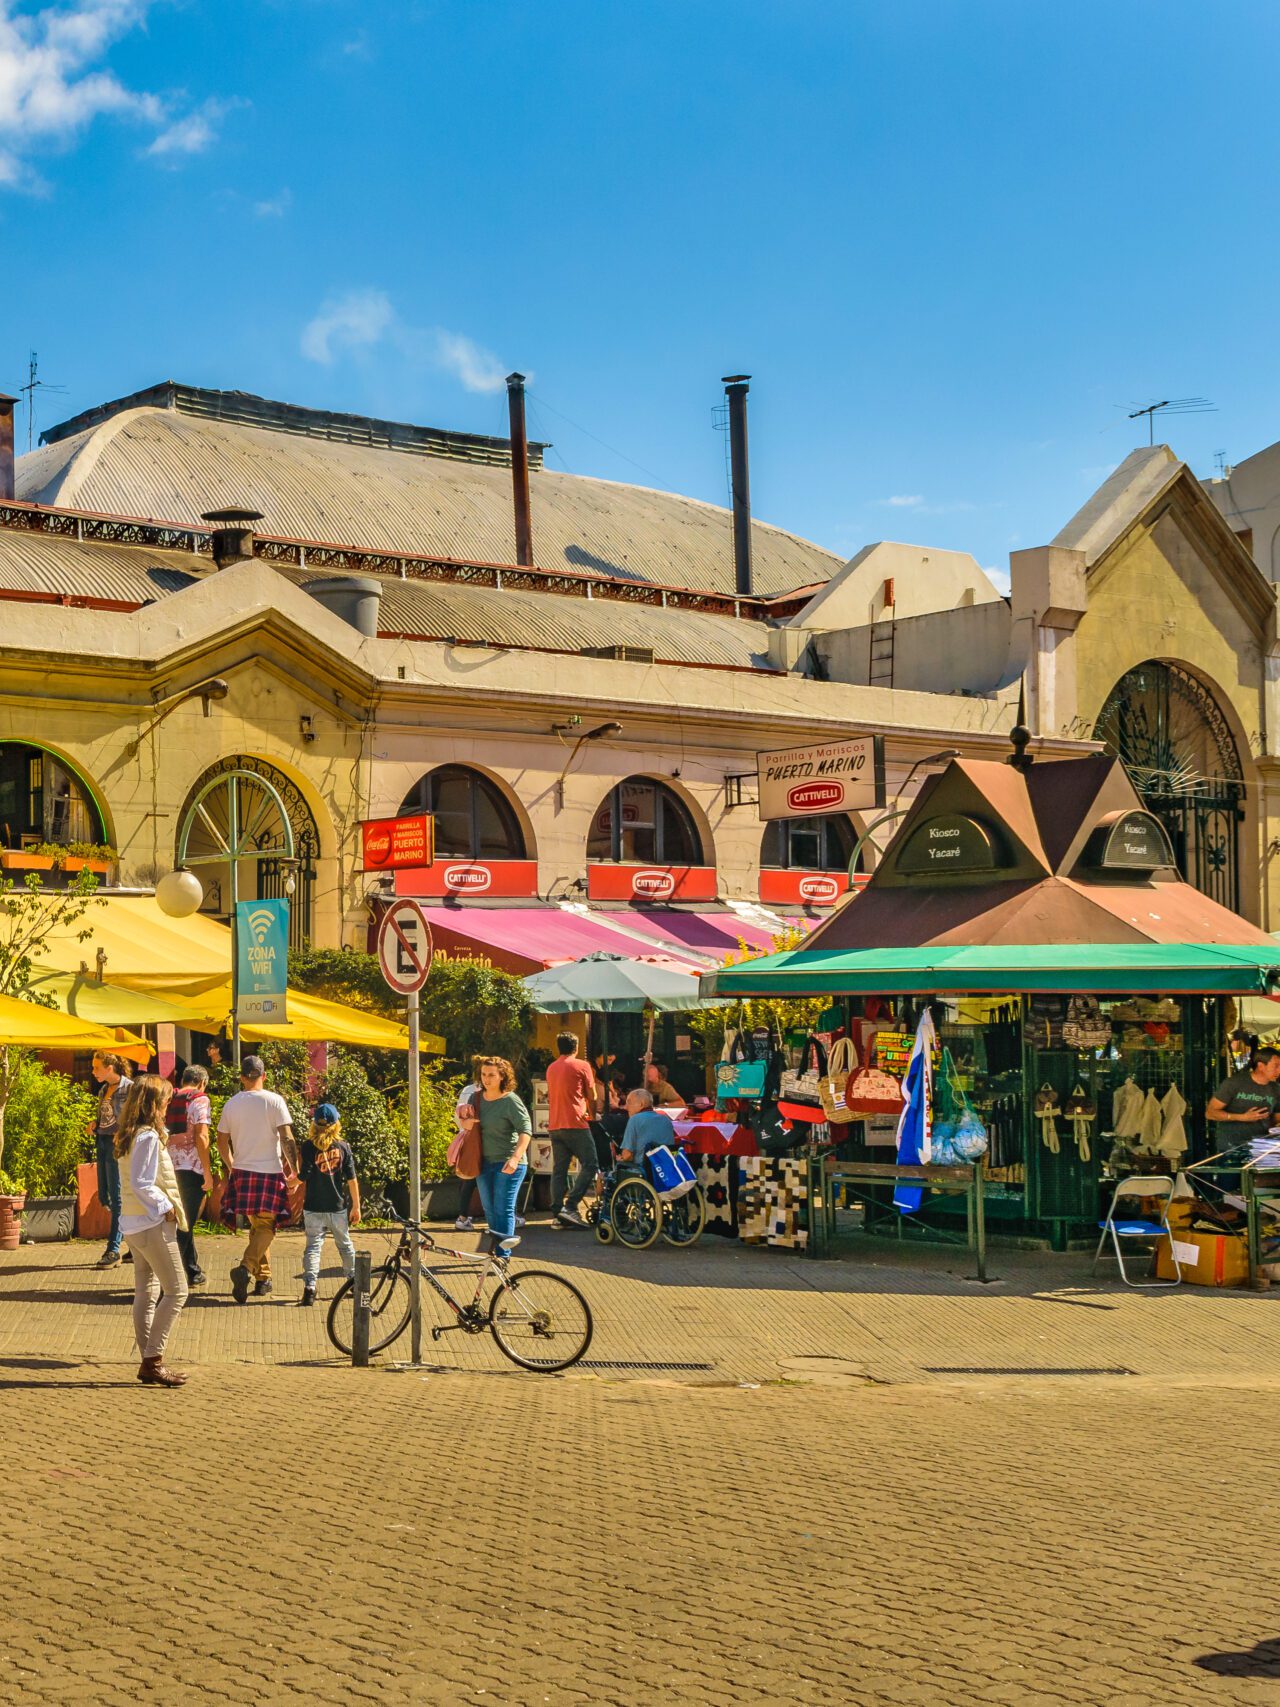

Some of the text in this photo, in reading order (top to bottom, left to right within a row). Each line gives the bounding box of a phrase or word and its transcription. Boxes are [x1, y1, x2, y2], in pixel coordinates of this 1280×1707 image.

[766, 743, 866, 764] Parrilla y Mariscos
[766, 754, 866, 782] PUERTO MARINO
[793, 788, 838, 802] CATTIVELLI
[396, 821, 420, 830] PARRILLA
[1124, 823, 1147, 835] Kiosco
[397, 829, 423, 838] MARISCOS
[929, 828, 960, 838] Kiosco
[393, 838, 424, 849] PUERTO
[393, 849, 424, 861] MARINO
[928, 847, 960, 859] Yacaré
[448, 873, 487, 883] CATTIVELLI
[247, 946, 276, 961] ZONA
[251, 961, 272, 976] WIFI
[1236, 1092, 1265, 1102] Hurley
